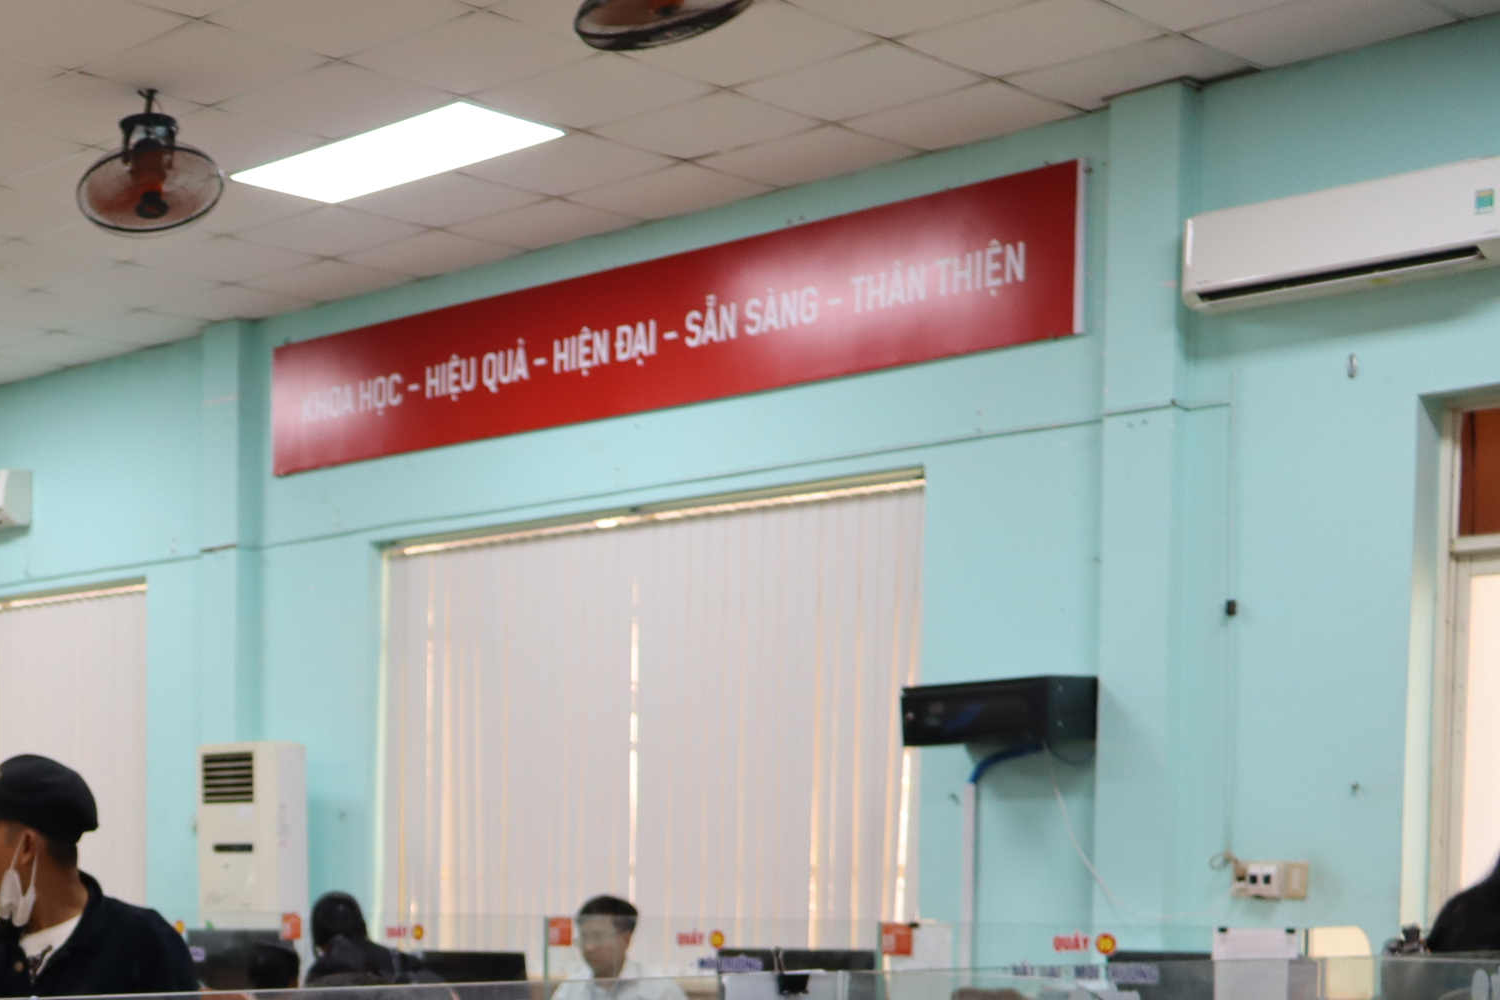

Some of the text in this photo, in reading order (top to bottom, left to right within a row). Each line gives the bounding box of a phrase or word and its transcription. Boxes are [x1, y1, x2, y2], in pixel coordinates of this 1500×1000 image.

[300, 238, 1026, 424] KHOA HỌC HIỆU QUẢ HIỆN ĐẠI SẴN SÀNG THÂN THIỆN
